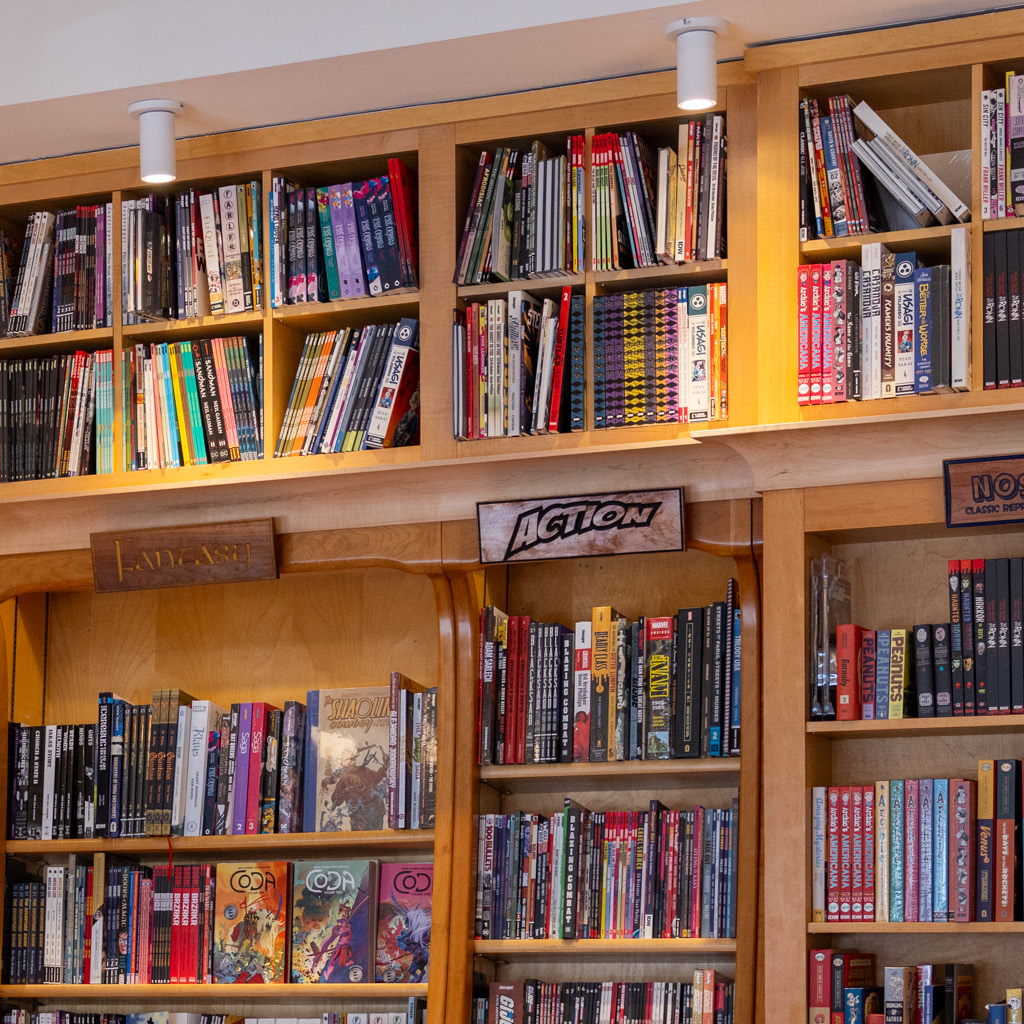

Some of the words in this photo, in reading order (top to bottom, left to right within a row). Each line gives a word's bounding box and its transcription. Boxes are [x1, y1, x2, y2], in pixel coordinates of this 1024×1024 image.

[477, 168, 490, 207] AFRODISIAC
[800, 314, 809, 369] AMERICANA
[503, 500, 664, 560] ACTION
[965, 505, 1000, 515] CLASSIC
[951, 594, 959, 623] HAUNTED
[863, 639, 874, 703] PEANUTS
[829, 834, 839, 889] AMERICANA
